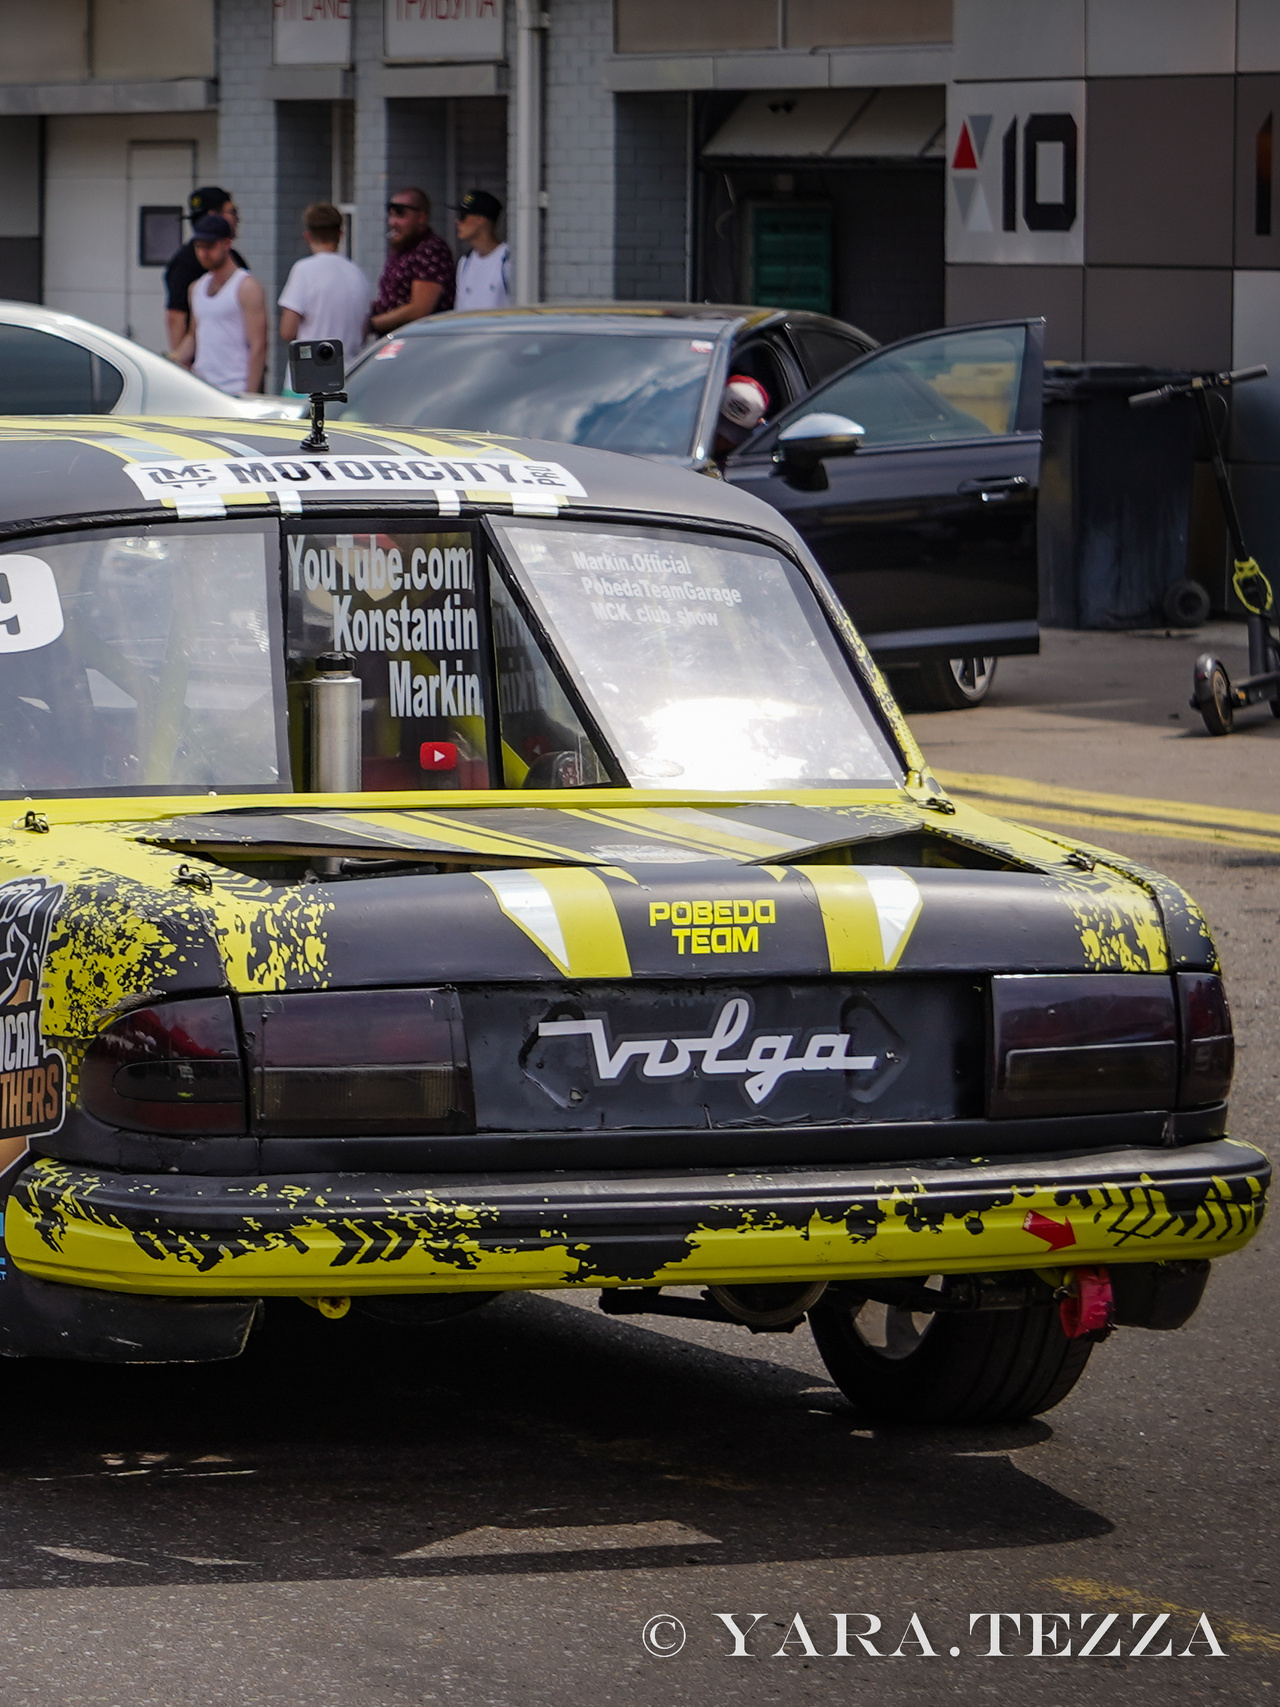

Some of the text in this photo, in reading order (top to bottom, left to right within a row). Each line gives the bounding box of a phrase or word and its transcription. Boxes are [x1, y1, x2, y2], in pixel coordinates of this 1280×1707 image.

[1002, 112, 1078, 233] 10
[581, 576, 743, 607] PobedaTeamGarage
[332, 593, 479, 653] Konstantin
[388, 659, 482, 718] Markin
[538, 998, 877, 1105] Volga
